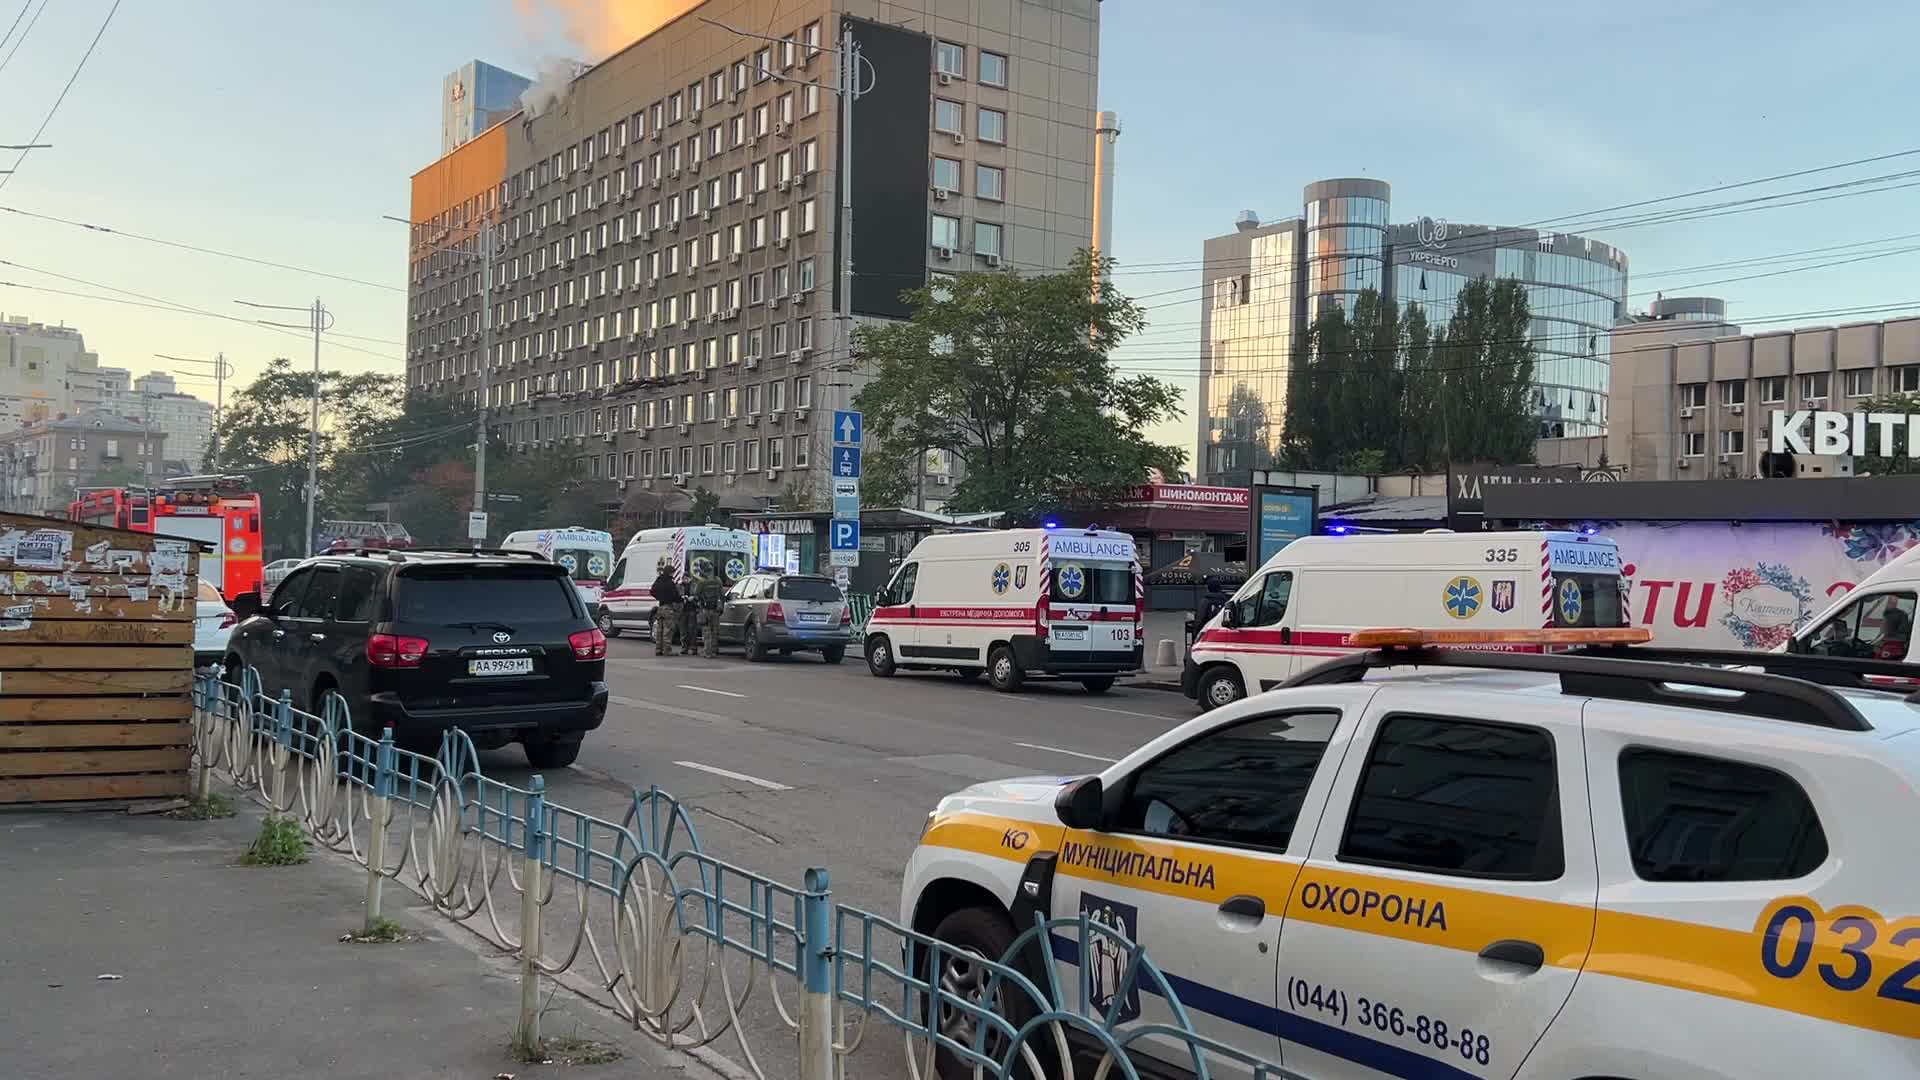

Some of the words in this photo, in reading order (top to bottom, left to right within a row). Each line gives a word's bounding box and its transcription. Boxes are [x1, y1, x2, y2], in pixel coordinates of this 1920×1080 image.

[1409, 251, 1458, 268] УКРЕНЕРГО
[1159, 488, 1244, 503] ШИНОМОНТАЖ
[556, 533, 608, 543] AMBULANCE
[689, 537, 748, 549] AMBULANCE
[1013, 541, 1030, 552] 305
[1054, 541, 1129, 557] AMBULANCE
[1485, 548, 1518, 562] 335
[1554, 549, 1615, 567] AMBULANCE
[1110, 629, 1130, 641] 103
[475, 661, 490, 672] AA
[492, 660, 515, 671] 9949
[1001, 828, 1030, 850] КО
[1062, 841, 1215, 890] МУНІЦИПАЛЬНА
[1301, 882, 1447, 931] ОХОРОНА
[1288, 976, 1348, 1026] (044)
[1358, 997, 1490, 1066] 366-88-88
